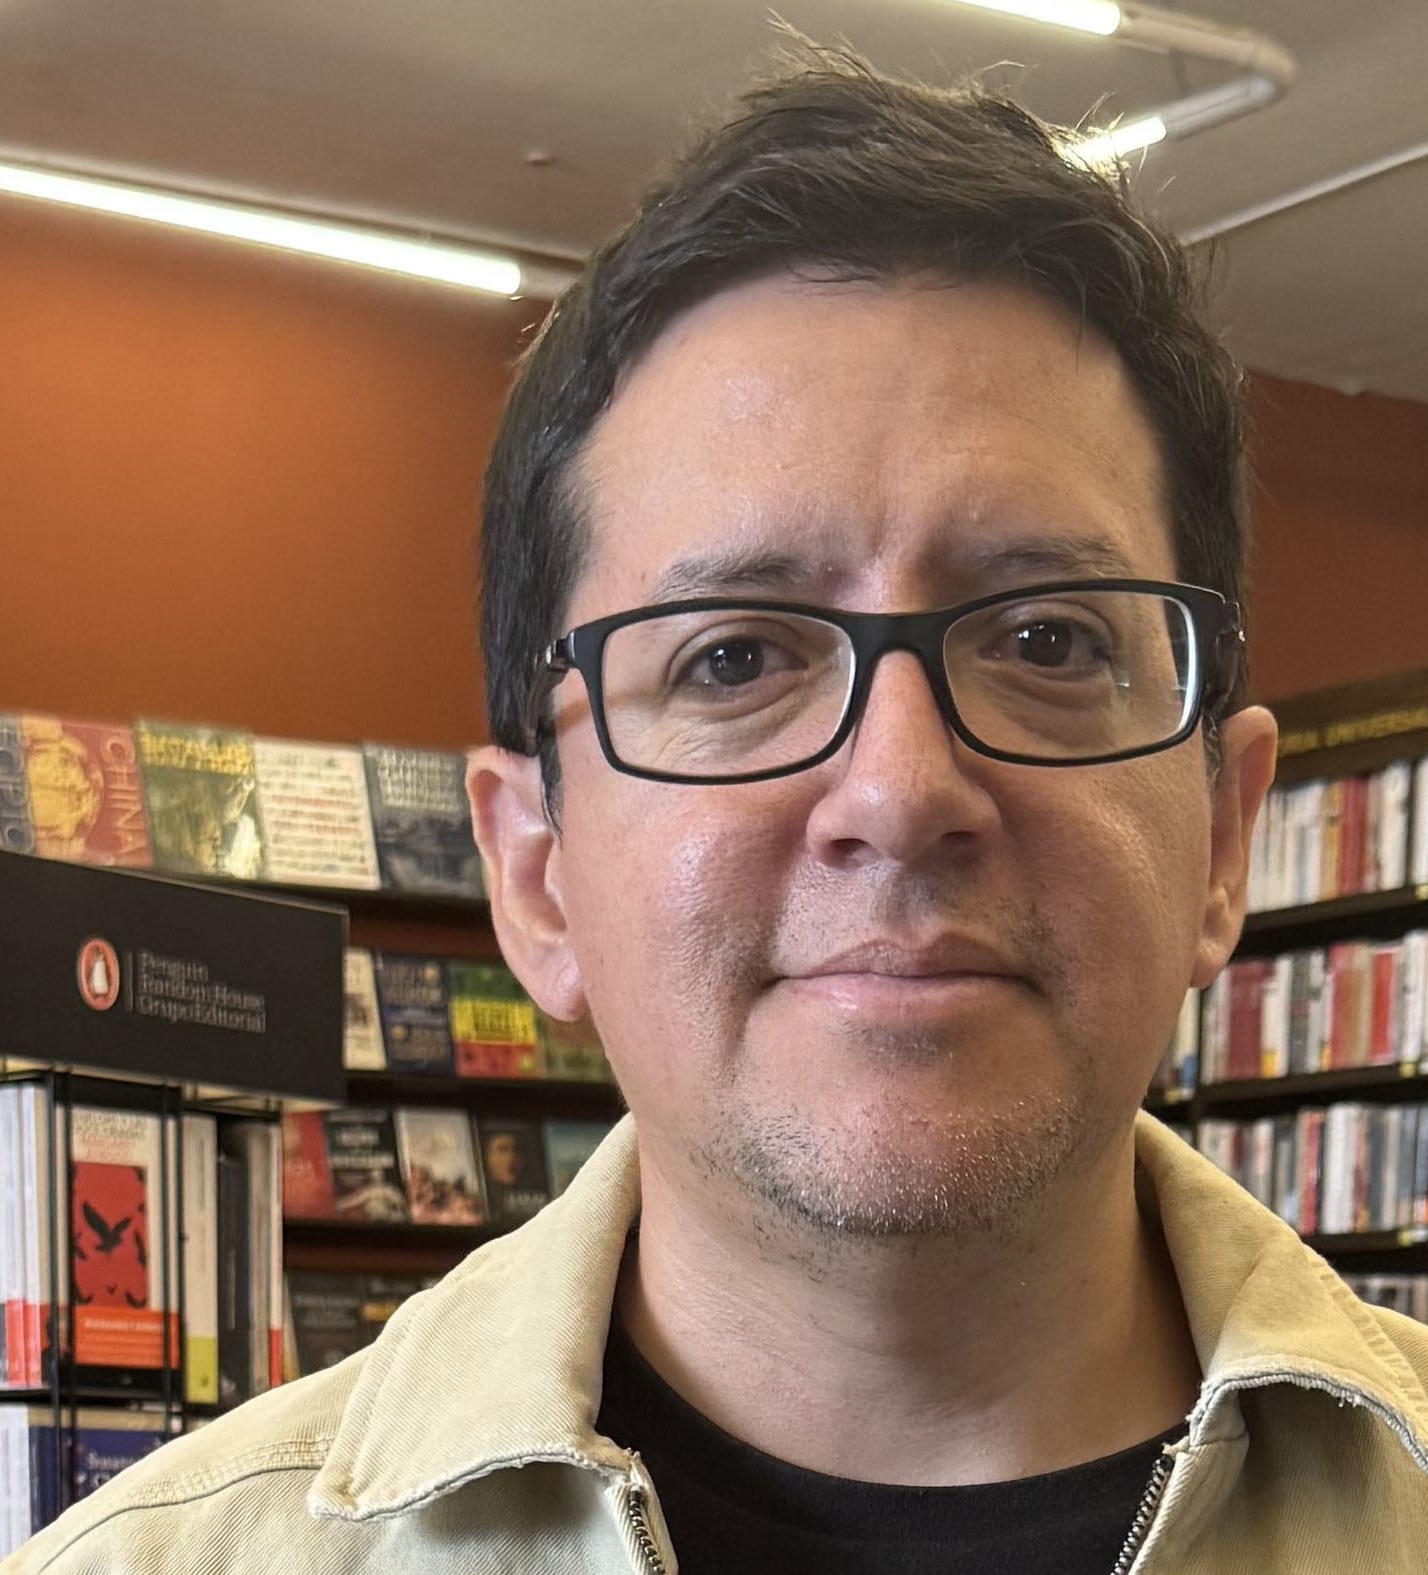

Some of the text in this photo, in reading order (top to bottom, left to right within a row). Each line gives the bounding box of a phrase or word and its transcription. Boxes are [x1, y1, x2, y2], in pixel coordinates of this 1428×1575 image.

[101, 738, 148, 853] CHINA
[141, 951, 209, 981] Penguin
[140, 974, 265, 1009] Random House
[195, 1004, 267, 1033] Editorial
